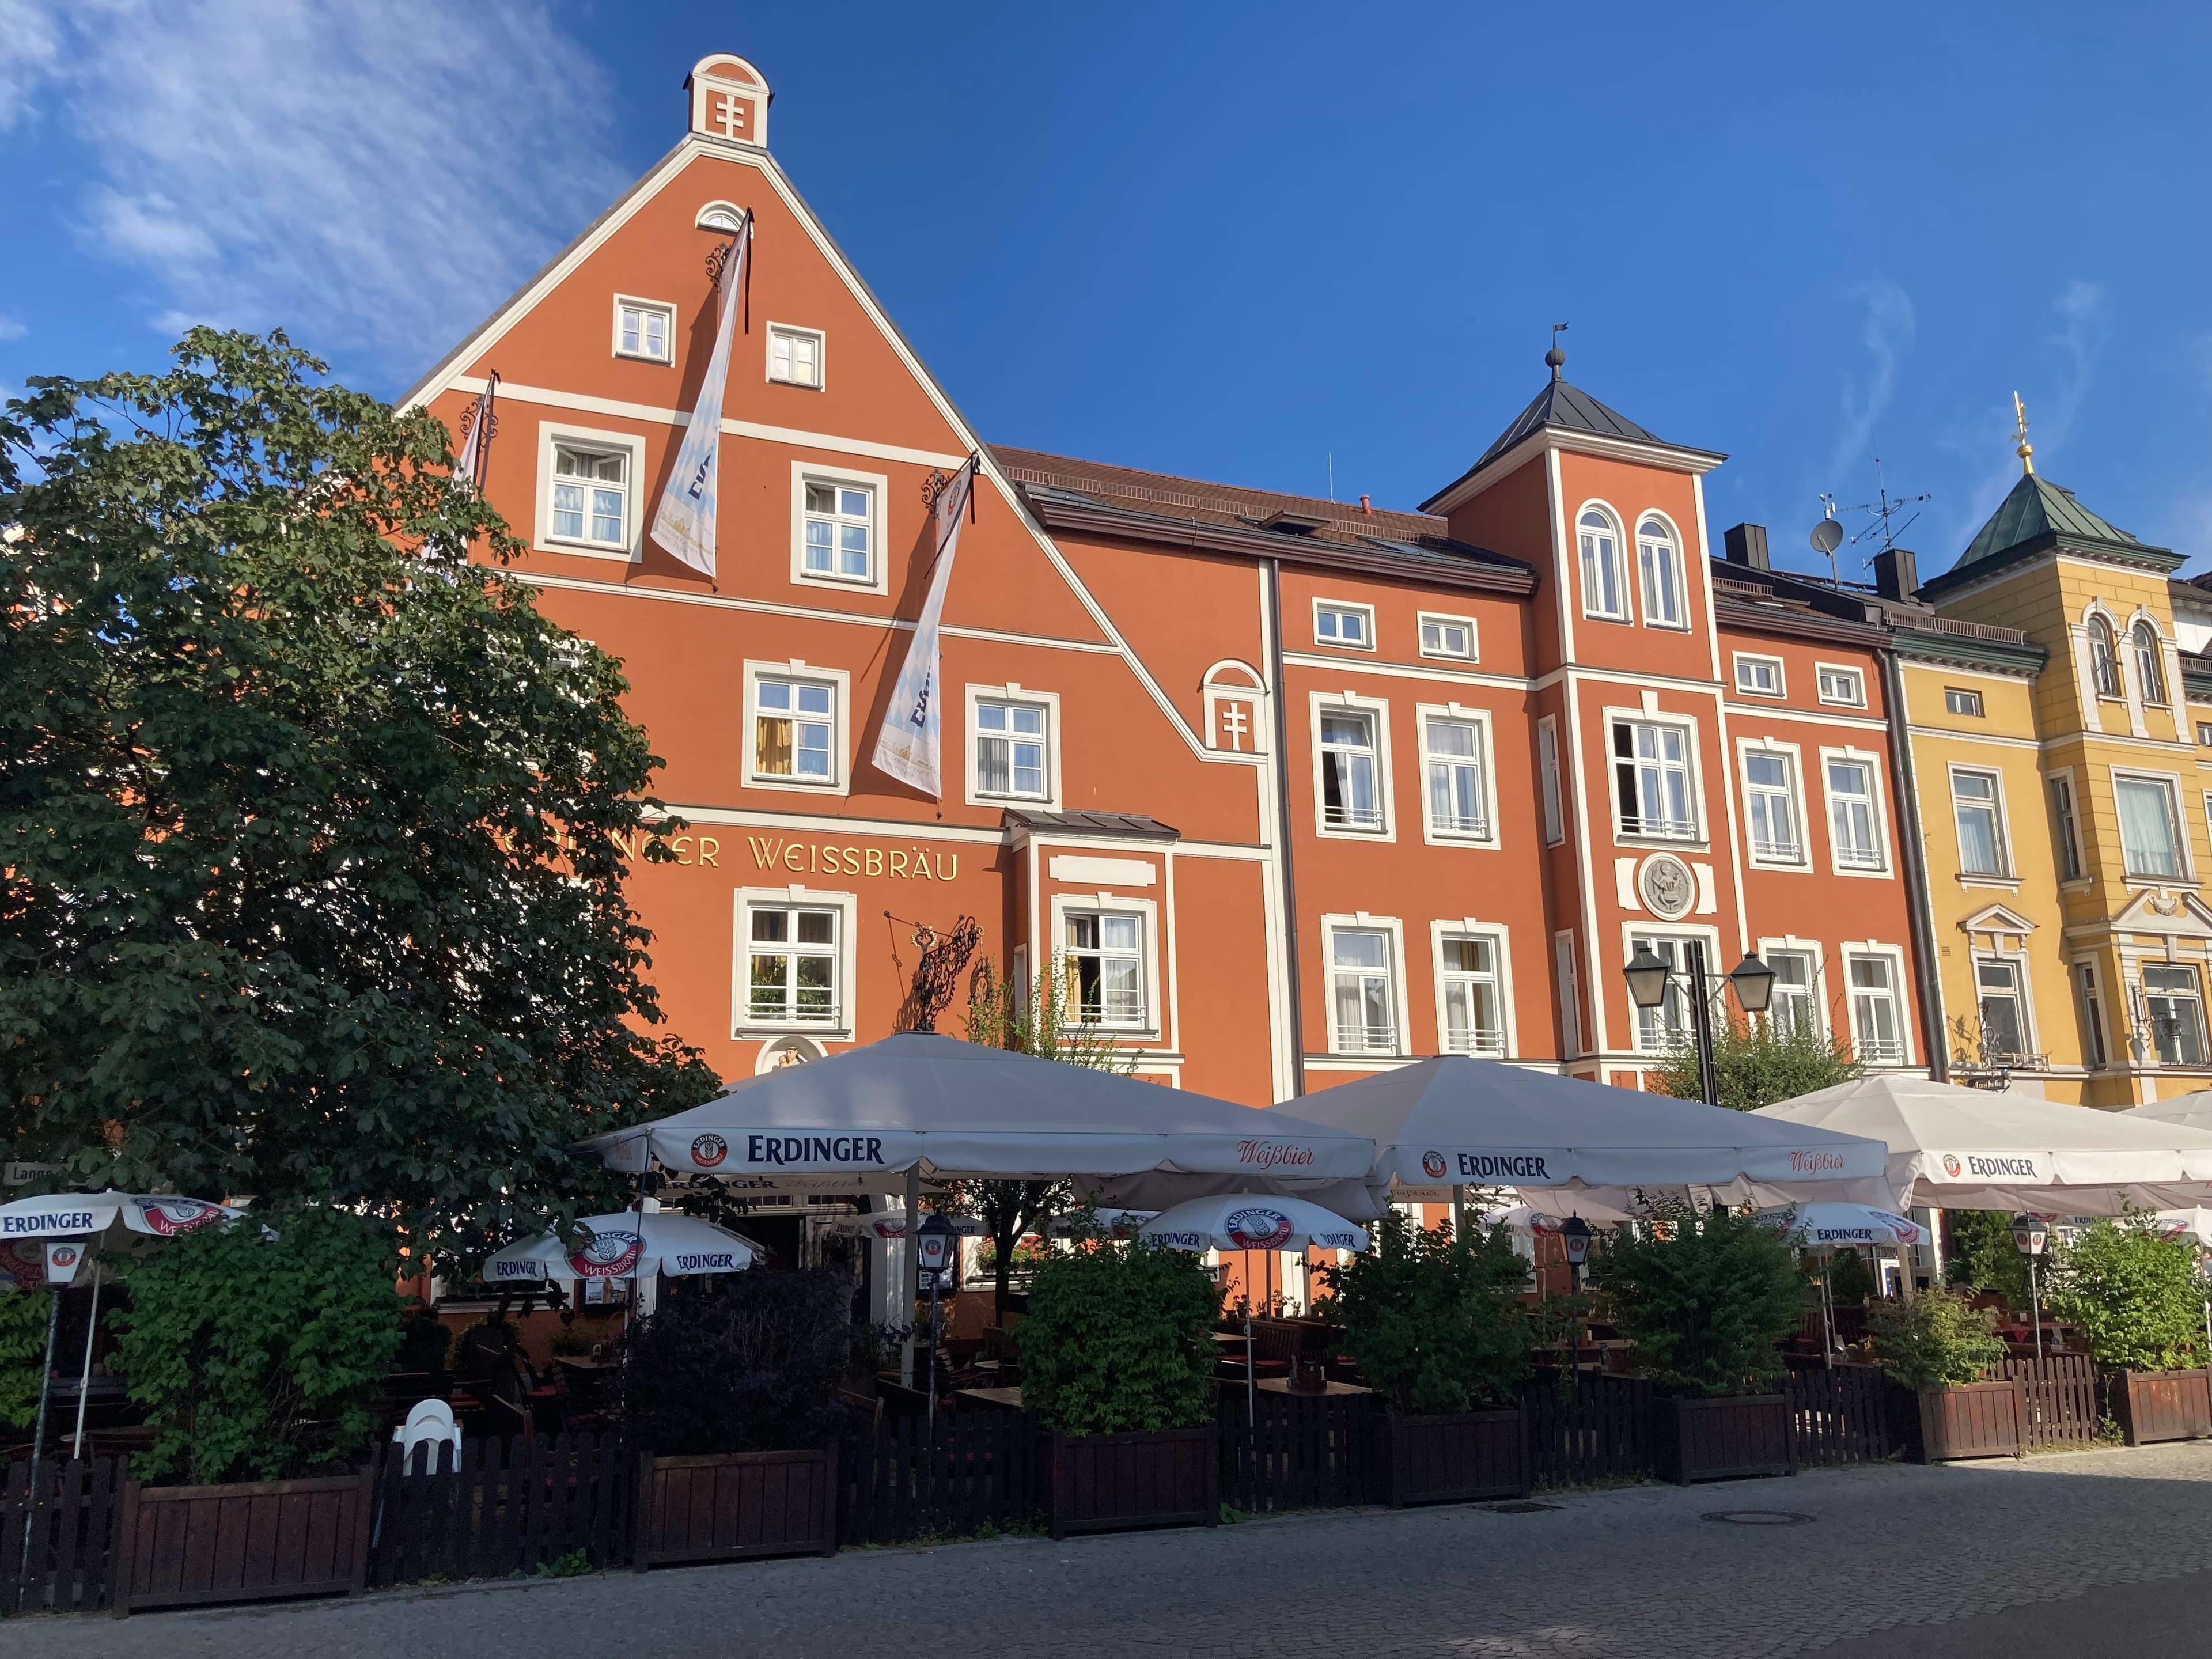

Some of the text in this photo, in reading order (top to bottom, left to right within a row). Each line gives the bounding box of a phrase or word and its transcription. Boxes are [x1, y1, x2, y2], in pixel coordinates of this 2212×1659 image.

[748, 837, 957, 881] WEISSBRÄU
[694, 1135, 725, 1148] ERDINGER
[748, 1135, 885, 1165] ERDINGER
[1237, 1139, 1315, 1170] Weißbier
[1788, 1151, 1846, 1175] Weißbier
[1457, 1153, 1551, 1179] ERDINGER
[1968, 1156, 2038, 1178] ERDINGER
[3, 1213, 92, 1232] ERDINGER
[1229, 1209, 1280, 1228] ERDINGER
[594, 1232, 637, 1243] INGER
[1817, 1229, 1873, 1240] ERDINGER
[677, 1255, 733, 1270] ERDINGER
